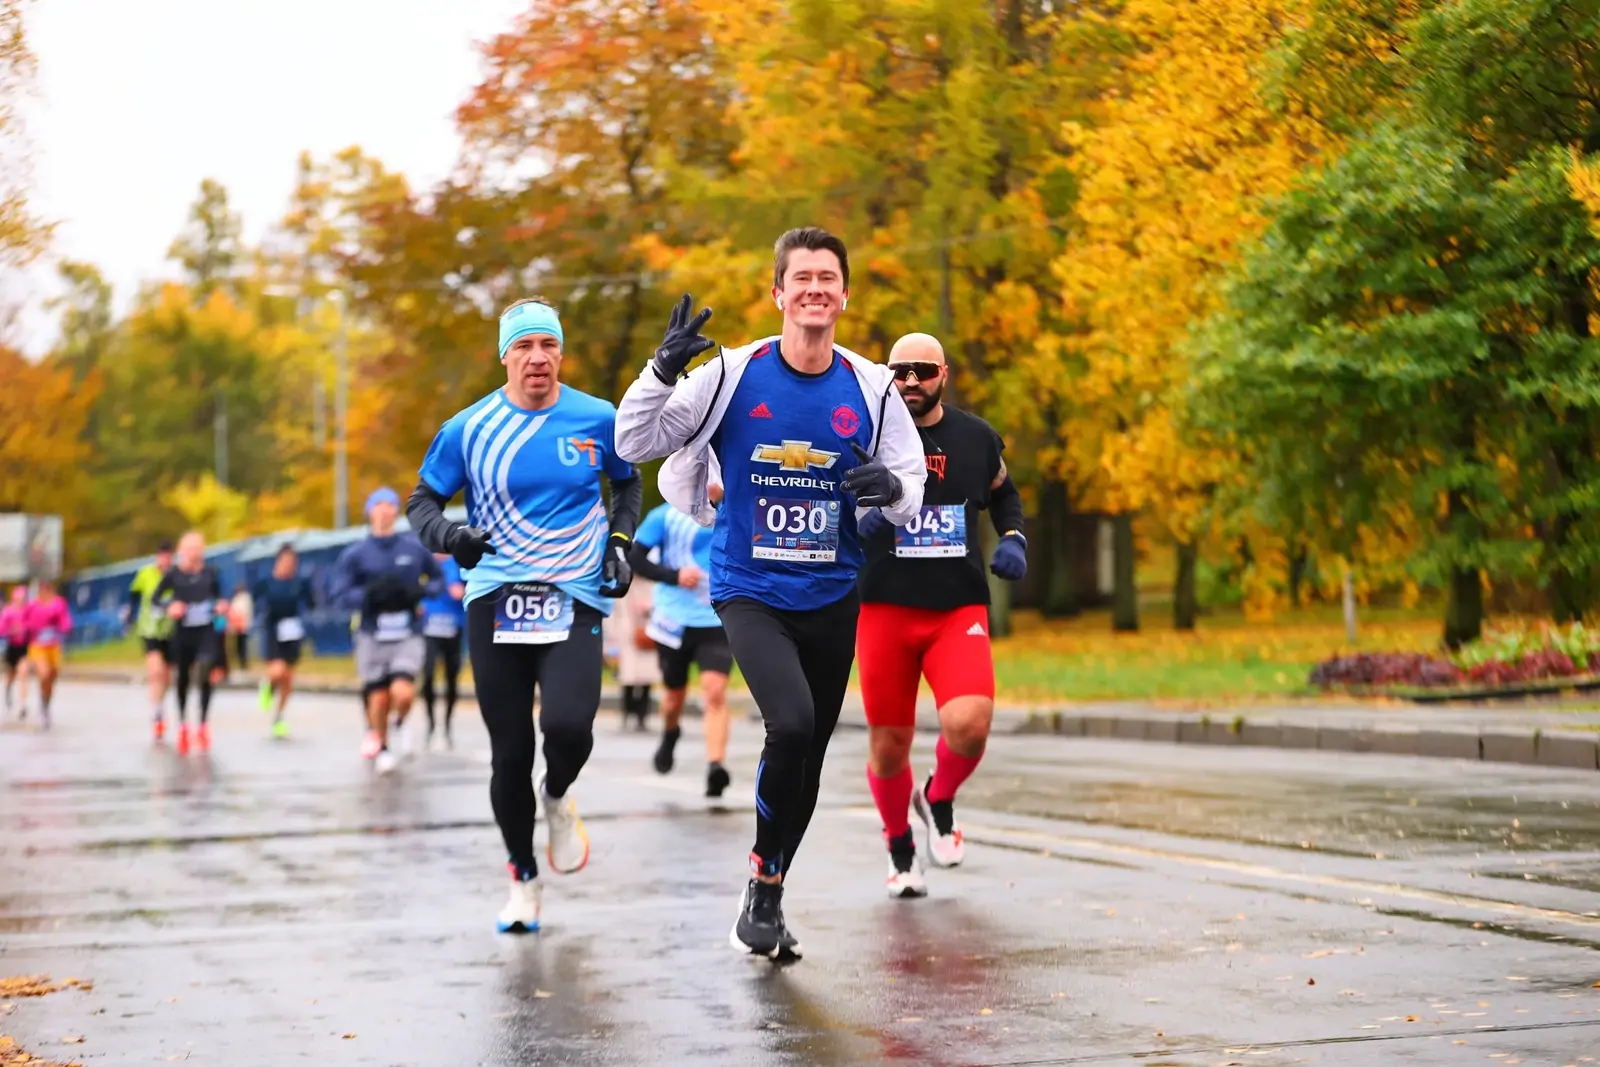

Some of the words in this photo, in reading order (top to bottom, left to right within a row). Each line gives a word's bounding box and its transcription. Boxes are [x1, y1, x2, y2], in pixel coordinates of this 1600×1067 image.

[751, 473, 836, 491] CHEVROLET
[766, 504, 828, 534] 030
[905, 510, 955, 534] 045
[505, 594, 560, 621] 056
